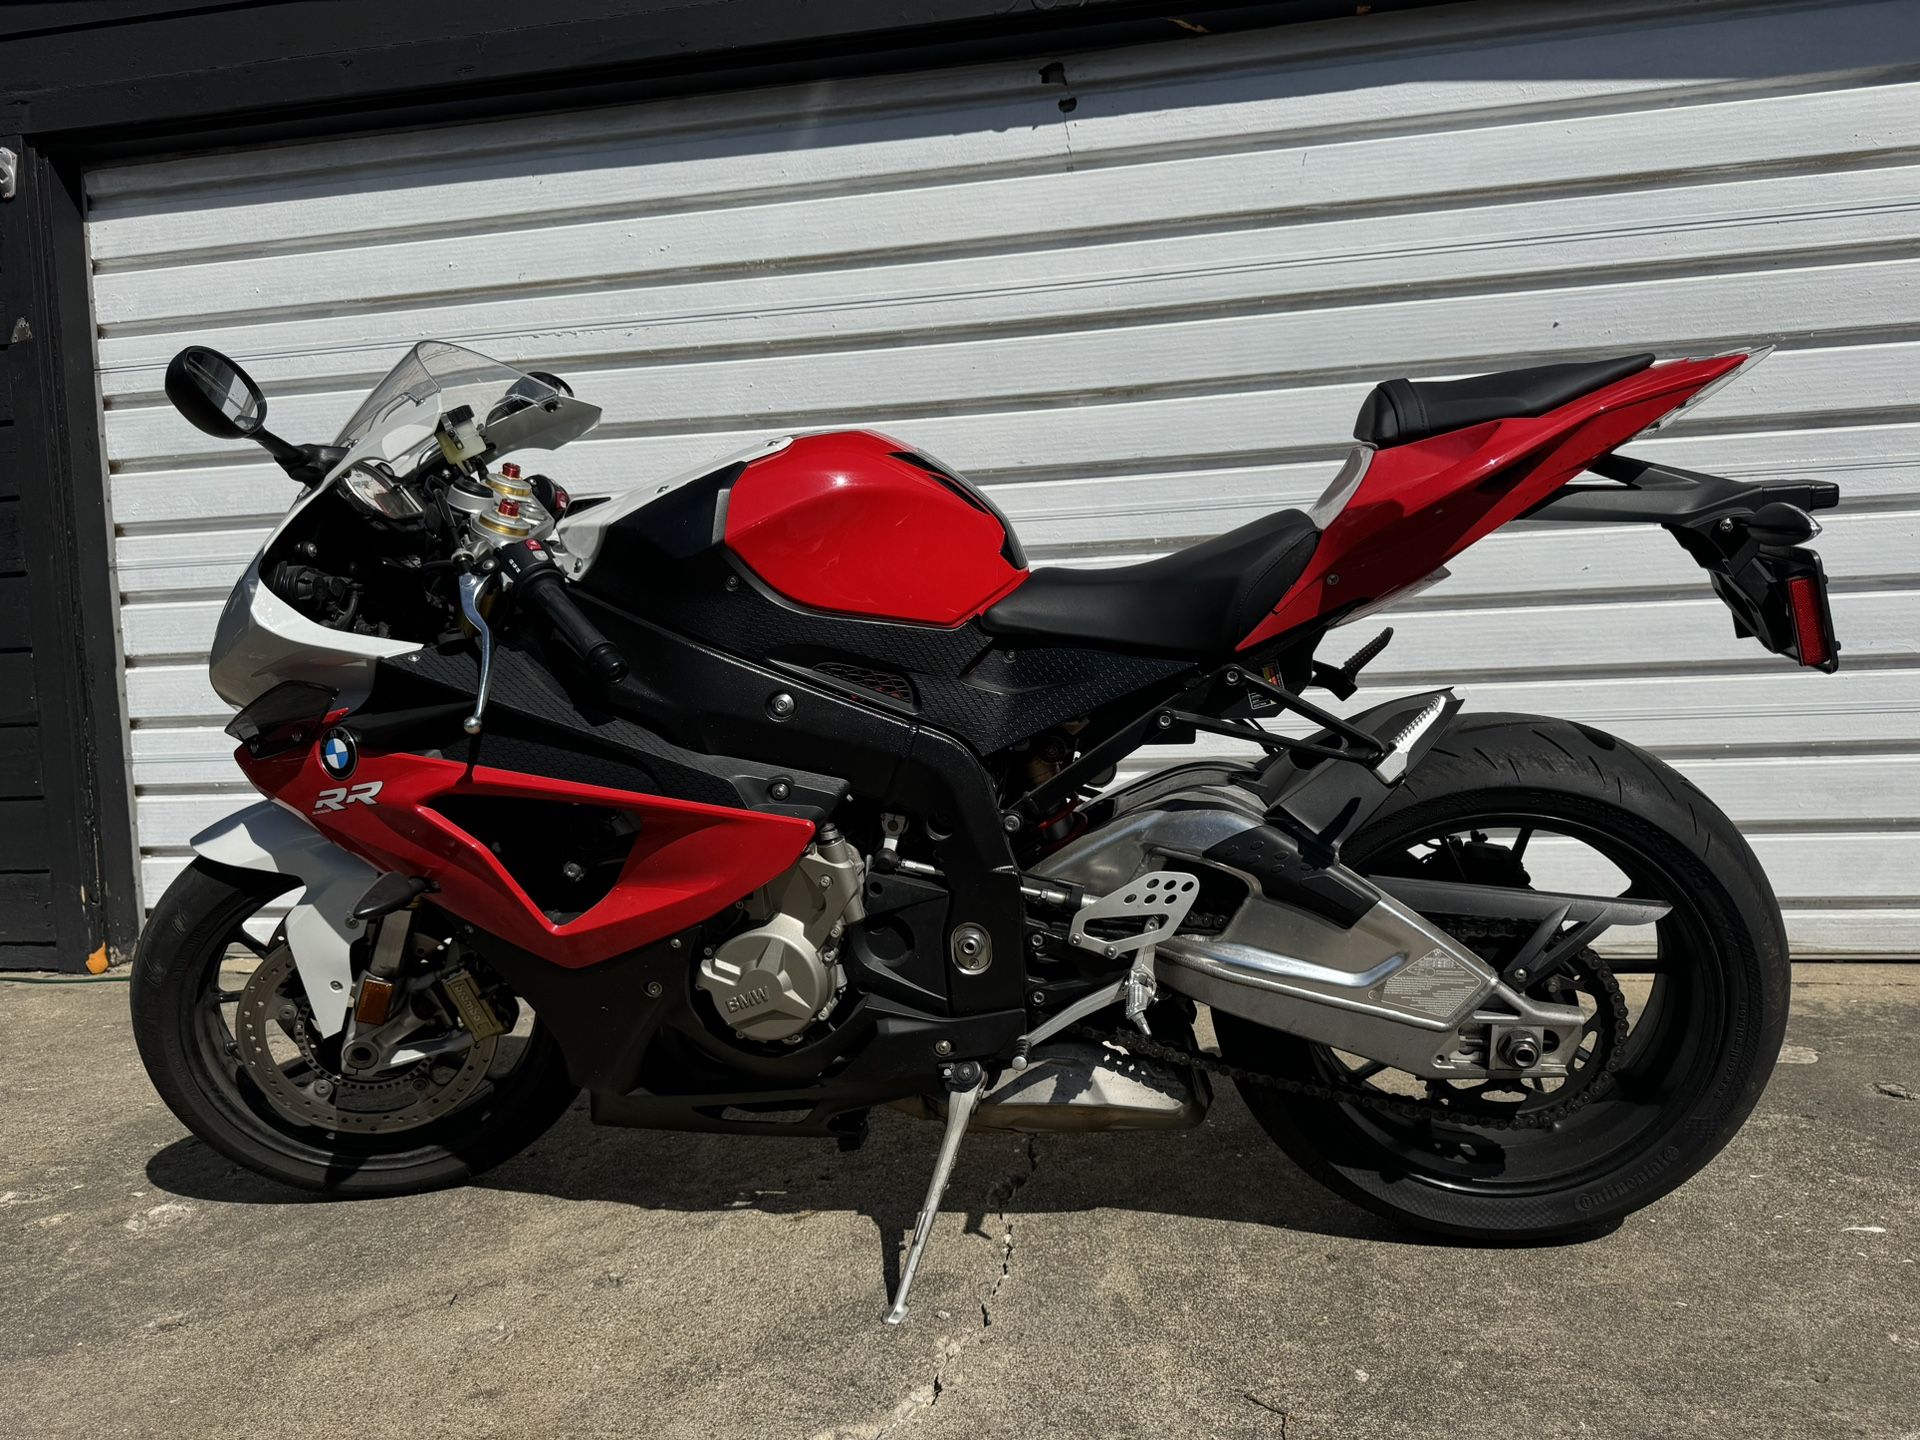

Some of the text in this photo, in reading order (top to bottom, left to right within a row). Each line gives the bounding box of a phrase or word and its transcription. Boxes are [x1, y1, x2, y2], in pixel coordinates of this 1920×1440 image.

[314, 781, 383, 811] RR
[455, 983, 480, 1021] brembo
[725, 985, 769, 1014] BMW
